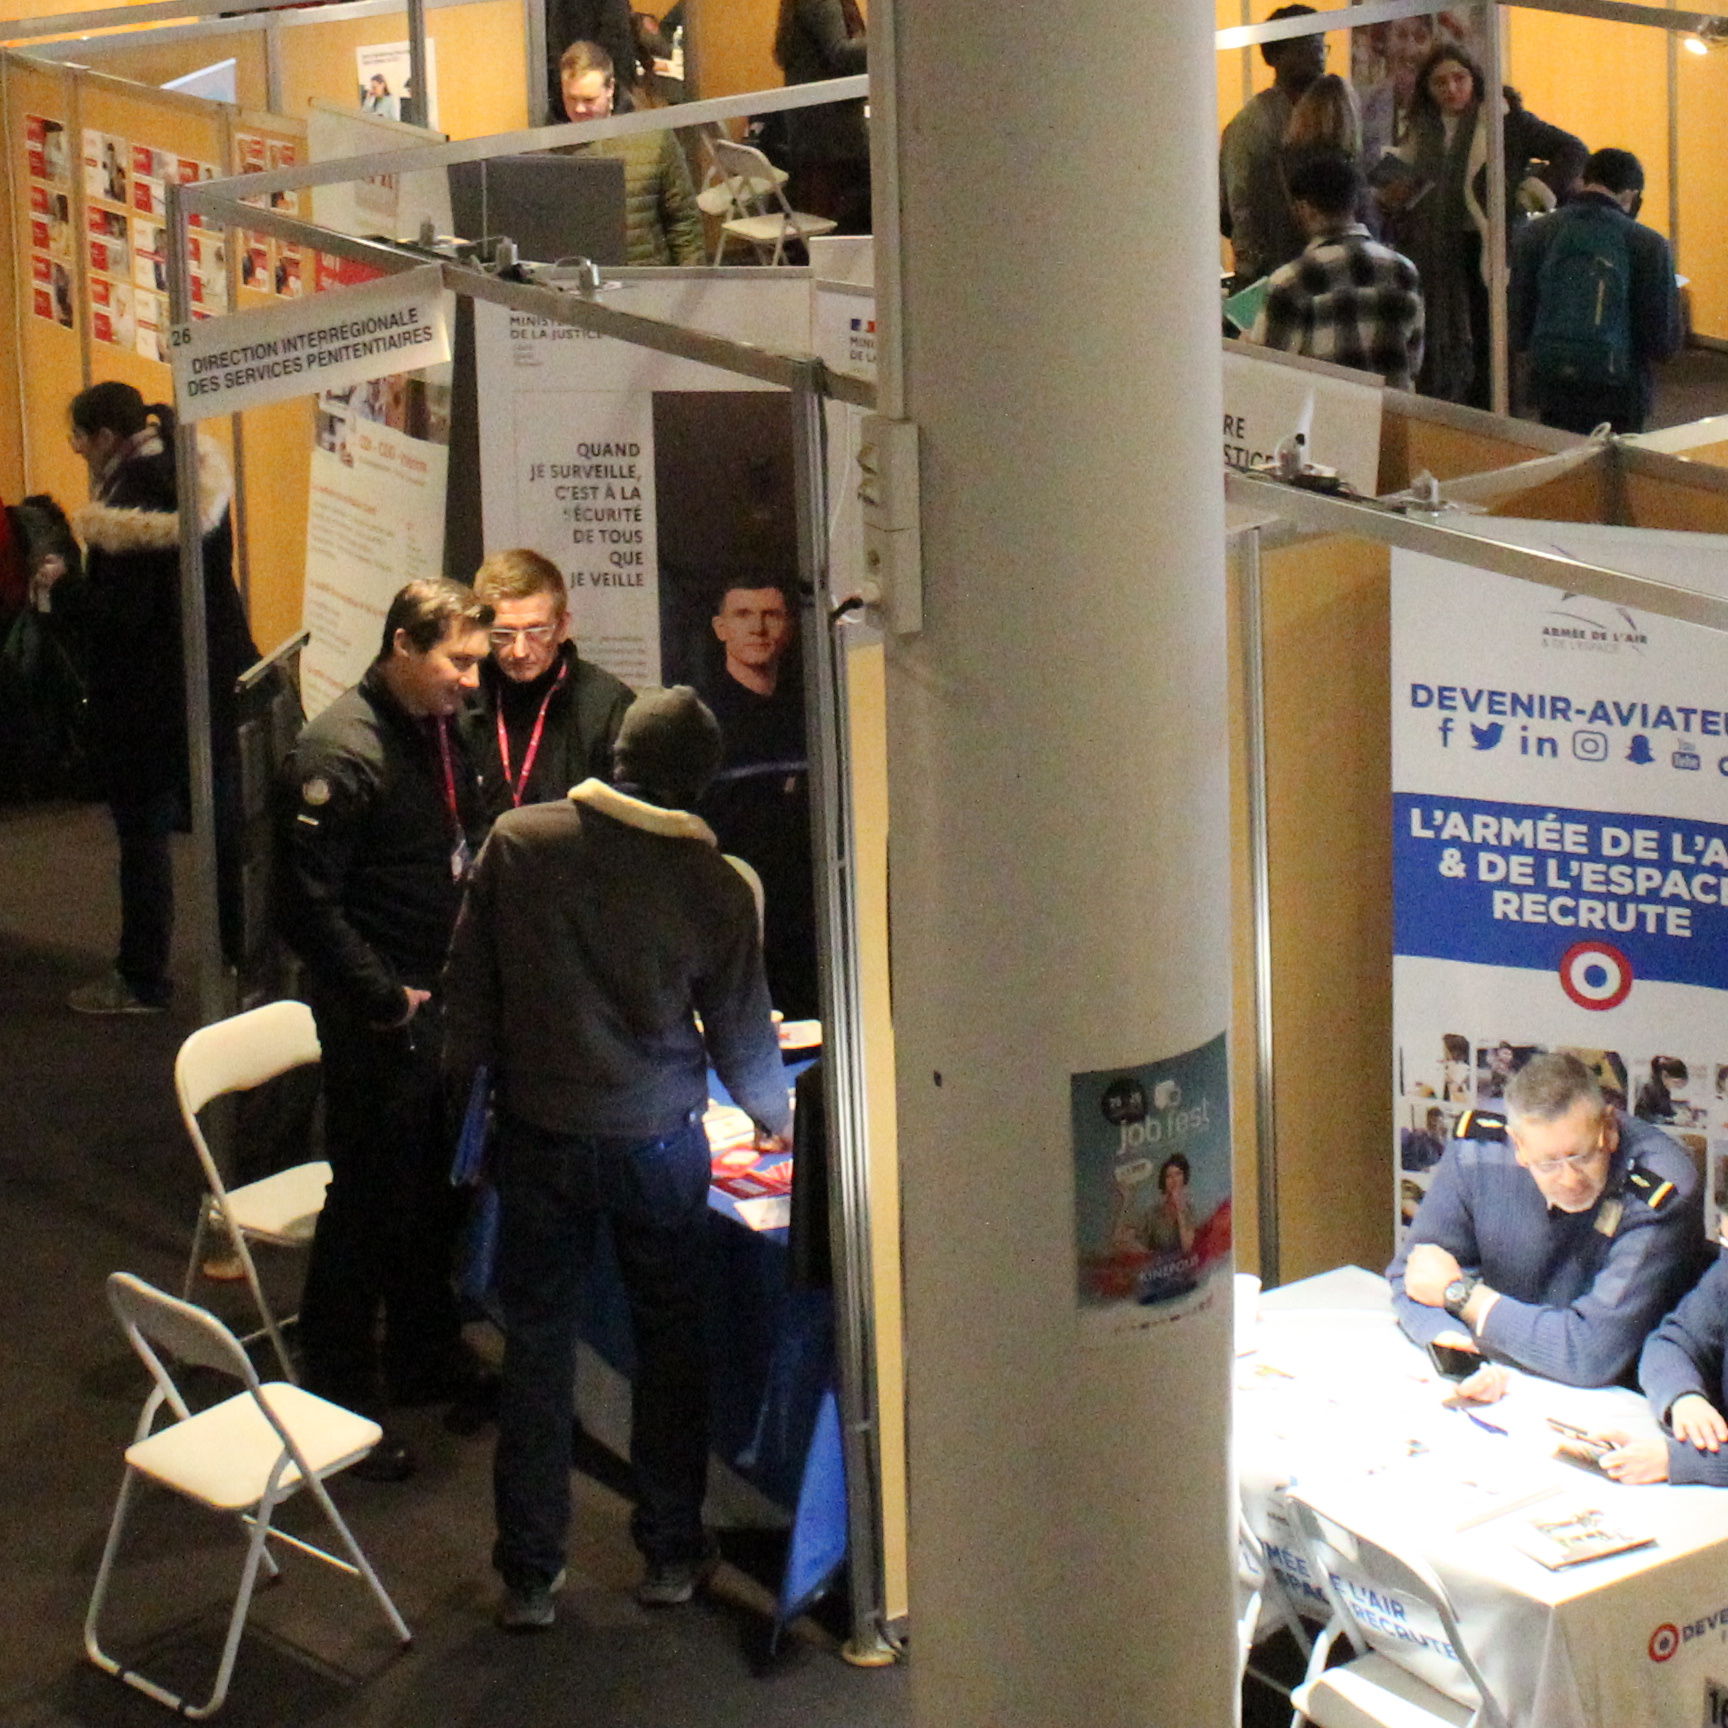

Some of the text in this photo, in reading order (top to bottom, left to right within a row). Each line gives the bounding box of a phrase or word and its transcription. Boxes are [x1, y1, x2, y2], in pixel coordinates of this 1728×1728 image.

[172, 328, 191, 347] 26
[531, 329, 547, 339] LA
[191, 342, 279, 375] DIRECTION
[187, 376, 221, 397] DES
[225, 356, 304, 389] SERVICES
[577, 442, 640, 459] QUAND
[530, 464, 642, 482] JE SURVEILLE,
[555, 483, 641, 501] C'EST À LA
[563, 504, 642, 522] ÉCURITÉ
[573, 529, 643, 544] DE TOUS
[609, 551, 644, 568] QUE
[571, 572, 645, 588] JE VEILLE
[1410, 806, 1589, 855] L'ARMÉE
[1602, 826, 1660, 860] DE
[1438, 848, 1466, 878] &
[1478, 851, 1535, 886] DE
[1493, 891, 1693, 938] RECRUTE
[1351, 1602, 1459, 1661] RECRUTE
